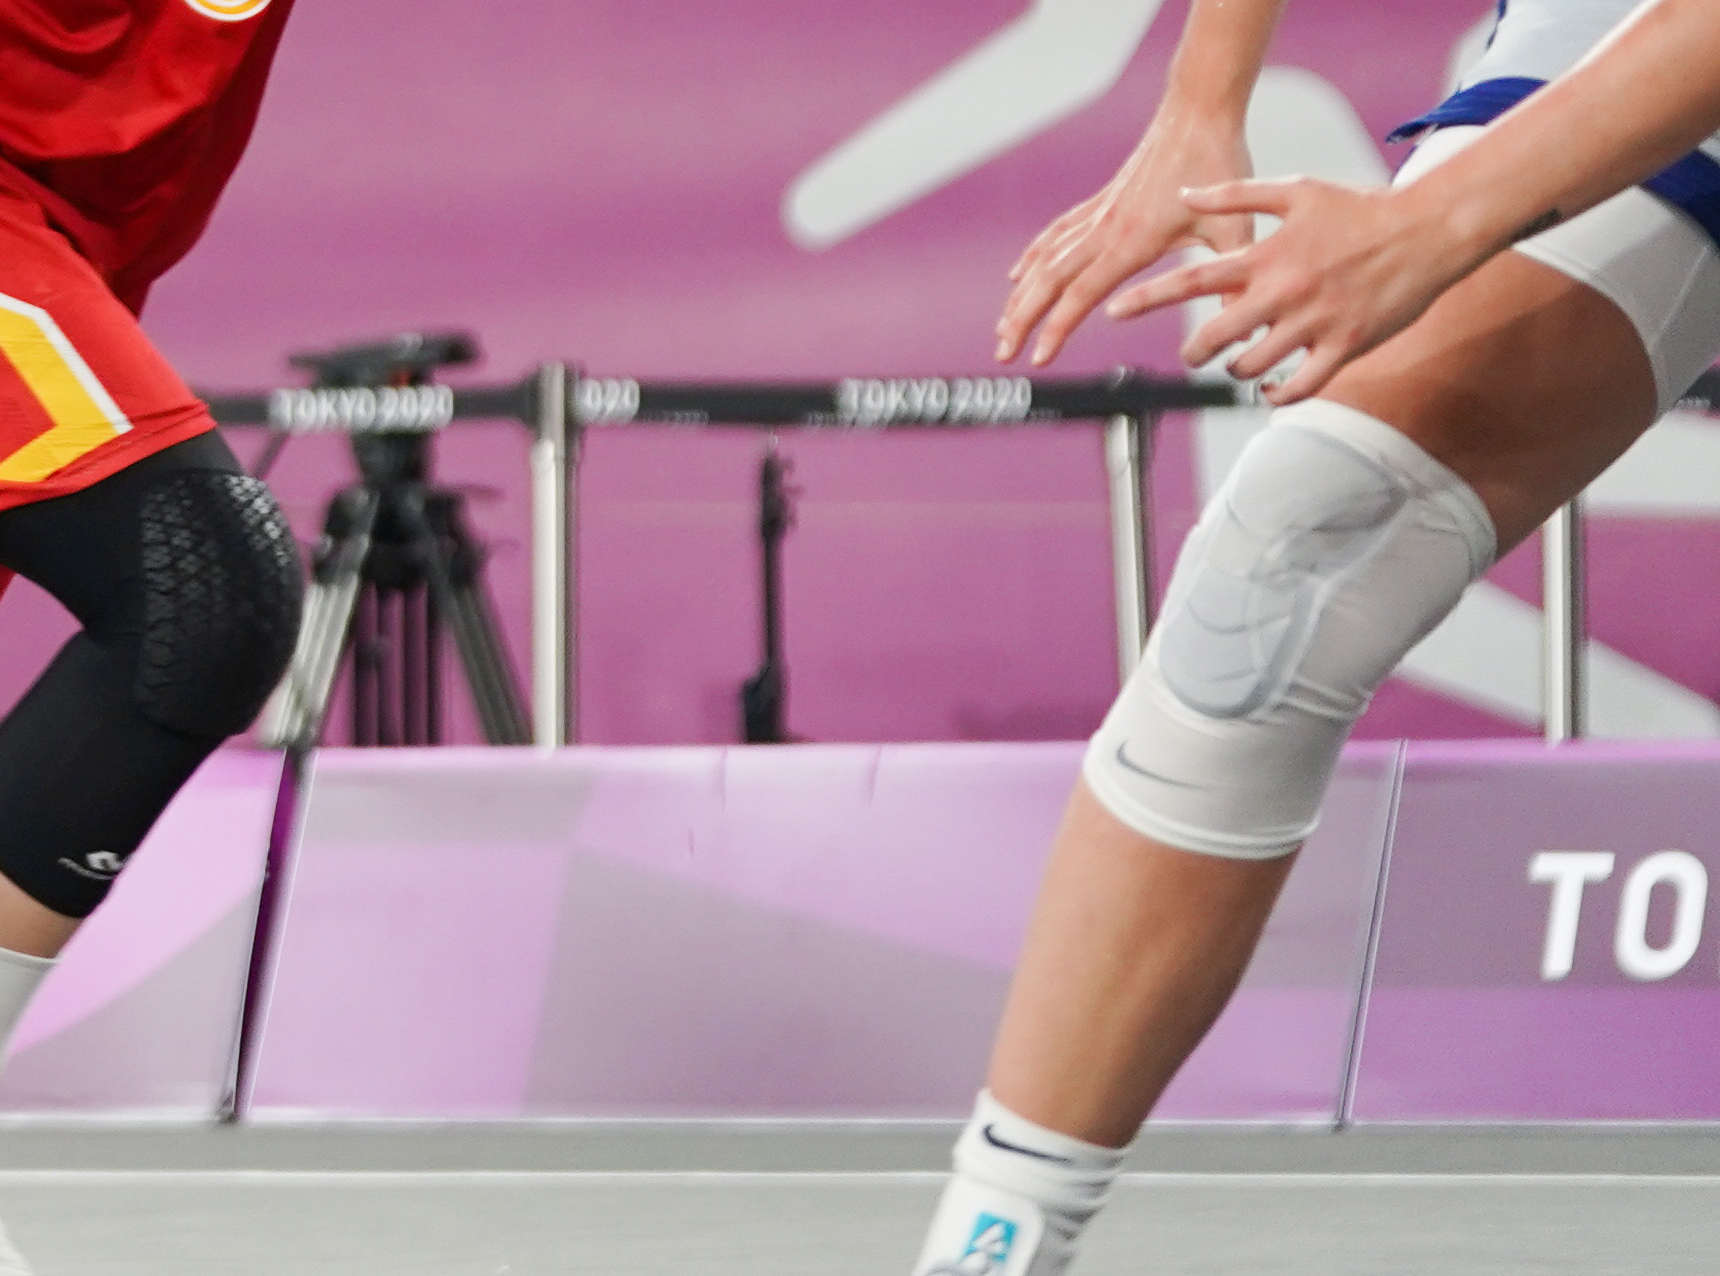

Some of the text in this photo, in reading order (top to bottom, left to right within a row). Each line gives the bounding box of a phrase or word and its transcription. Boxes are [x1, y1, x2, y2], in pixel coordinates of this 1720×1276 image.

[268, 384, 454, 434] TOKYO 2020
[572, 378, 640, 424] 020
[838, 377, 949, 427] TOKYO
[950, 376, 1032, 425] 2020
[1528, 850, 1709, 982] TO
